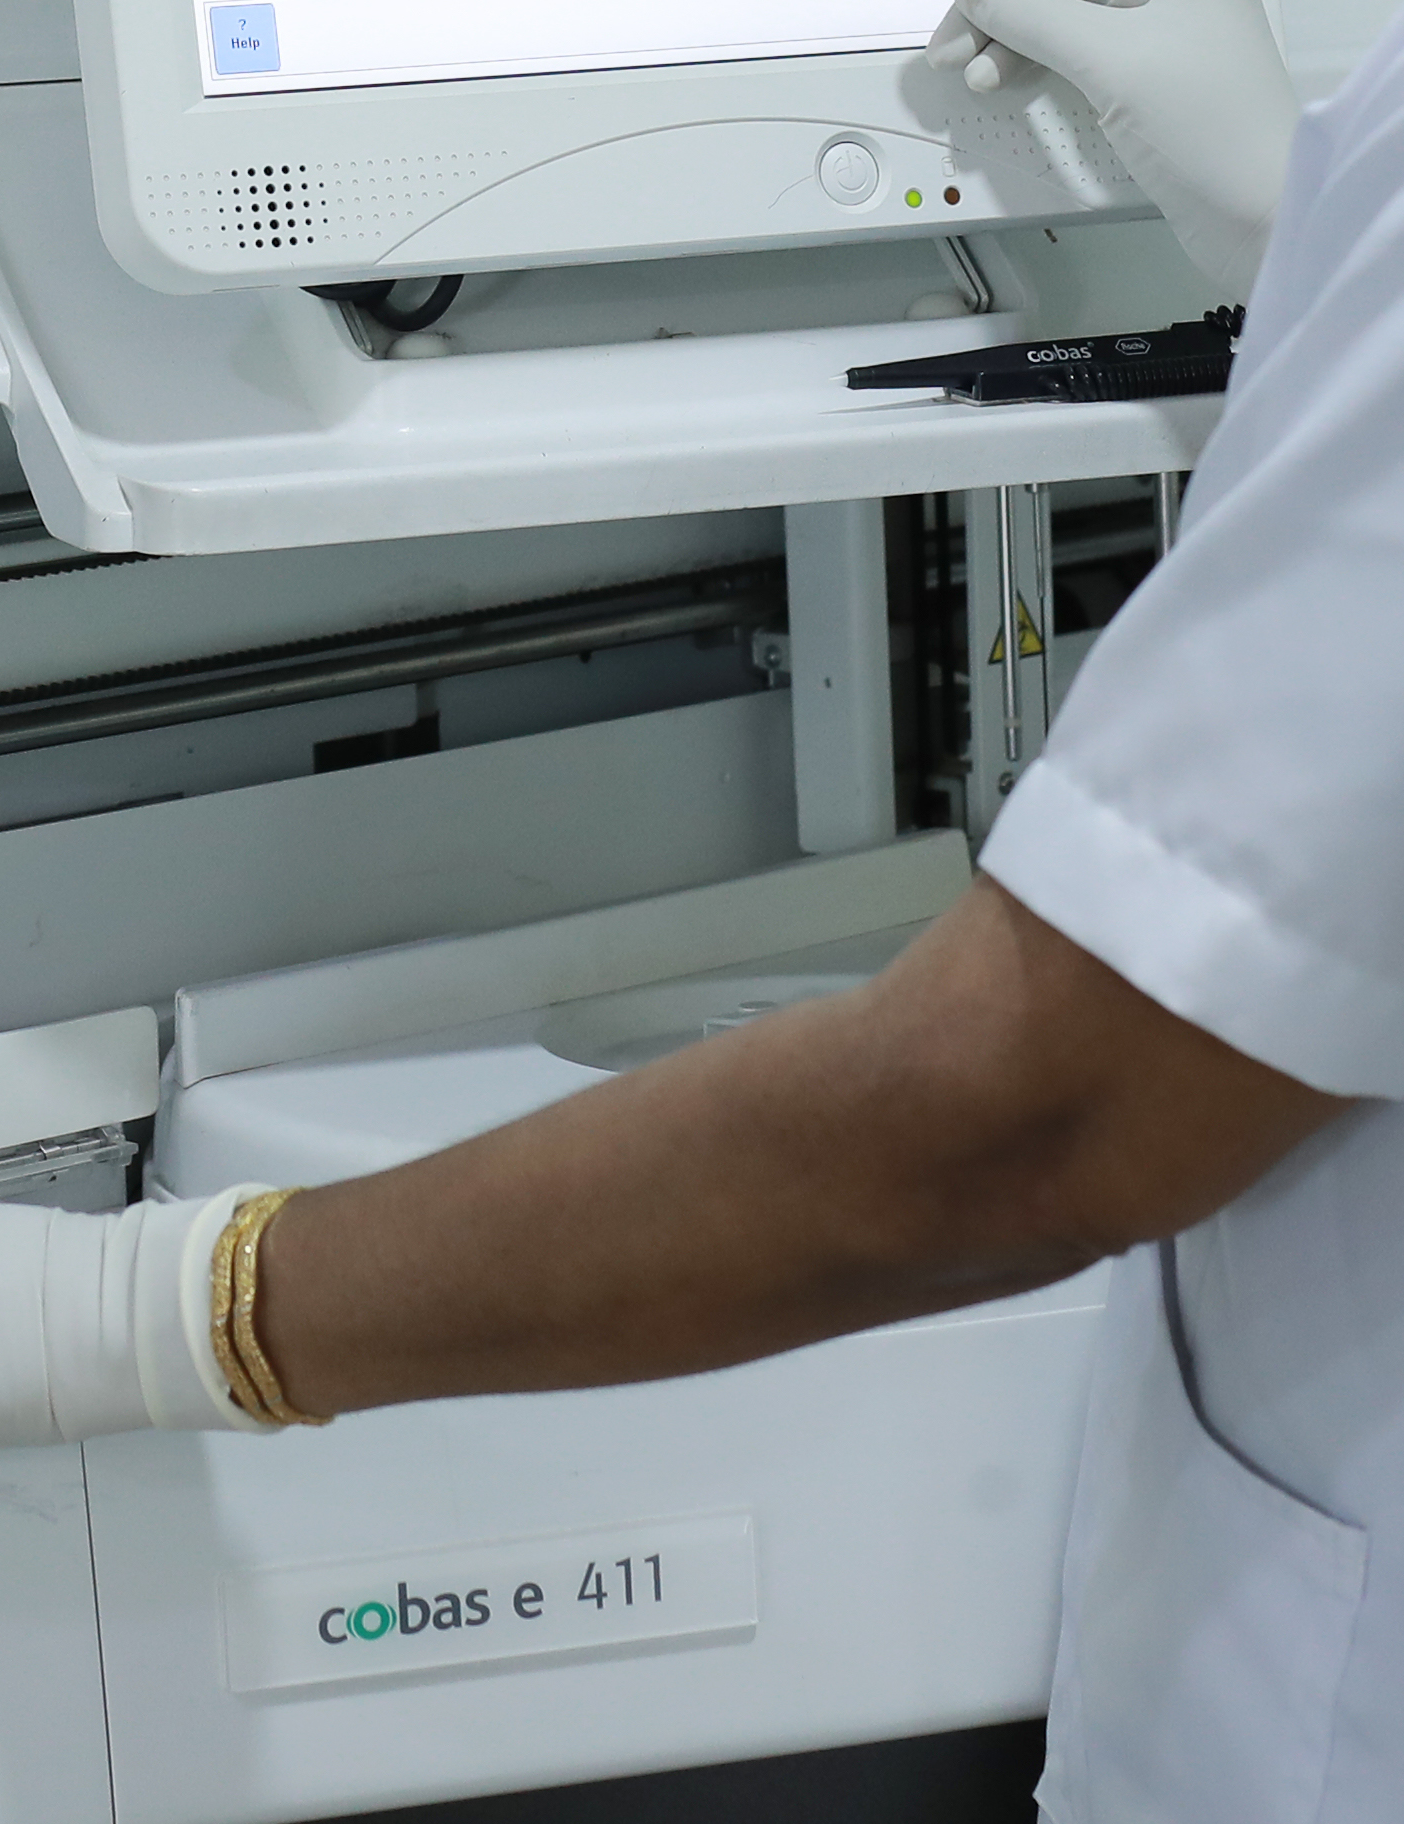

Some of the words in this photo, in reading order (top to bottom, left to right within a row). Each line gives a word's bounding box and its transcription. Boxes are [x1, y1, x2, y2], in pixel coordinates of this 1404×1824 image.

[231, 36, 260, 51] Help
[1027, 344, 1092, 363] cobas
[318, 1581, 492, 1645] cobas
[512, 1581, 545, 1619] e
[576, 1553, 662, 1610] 411
